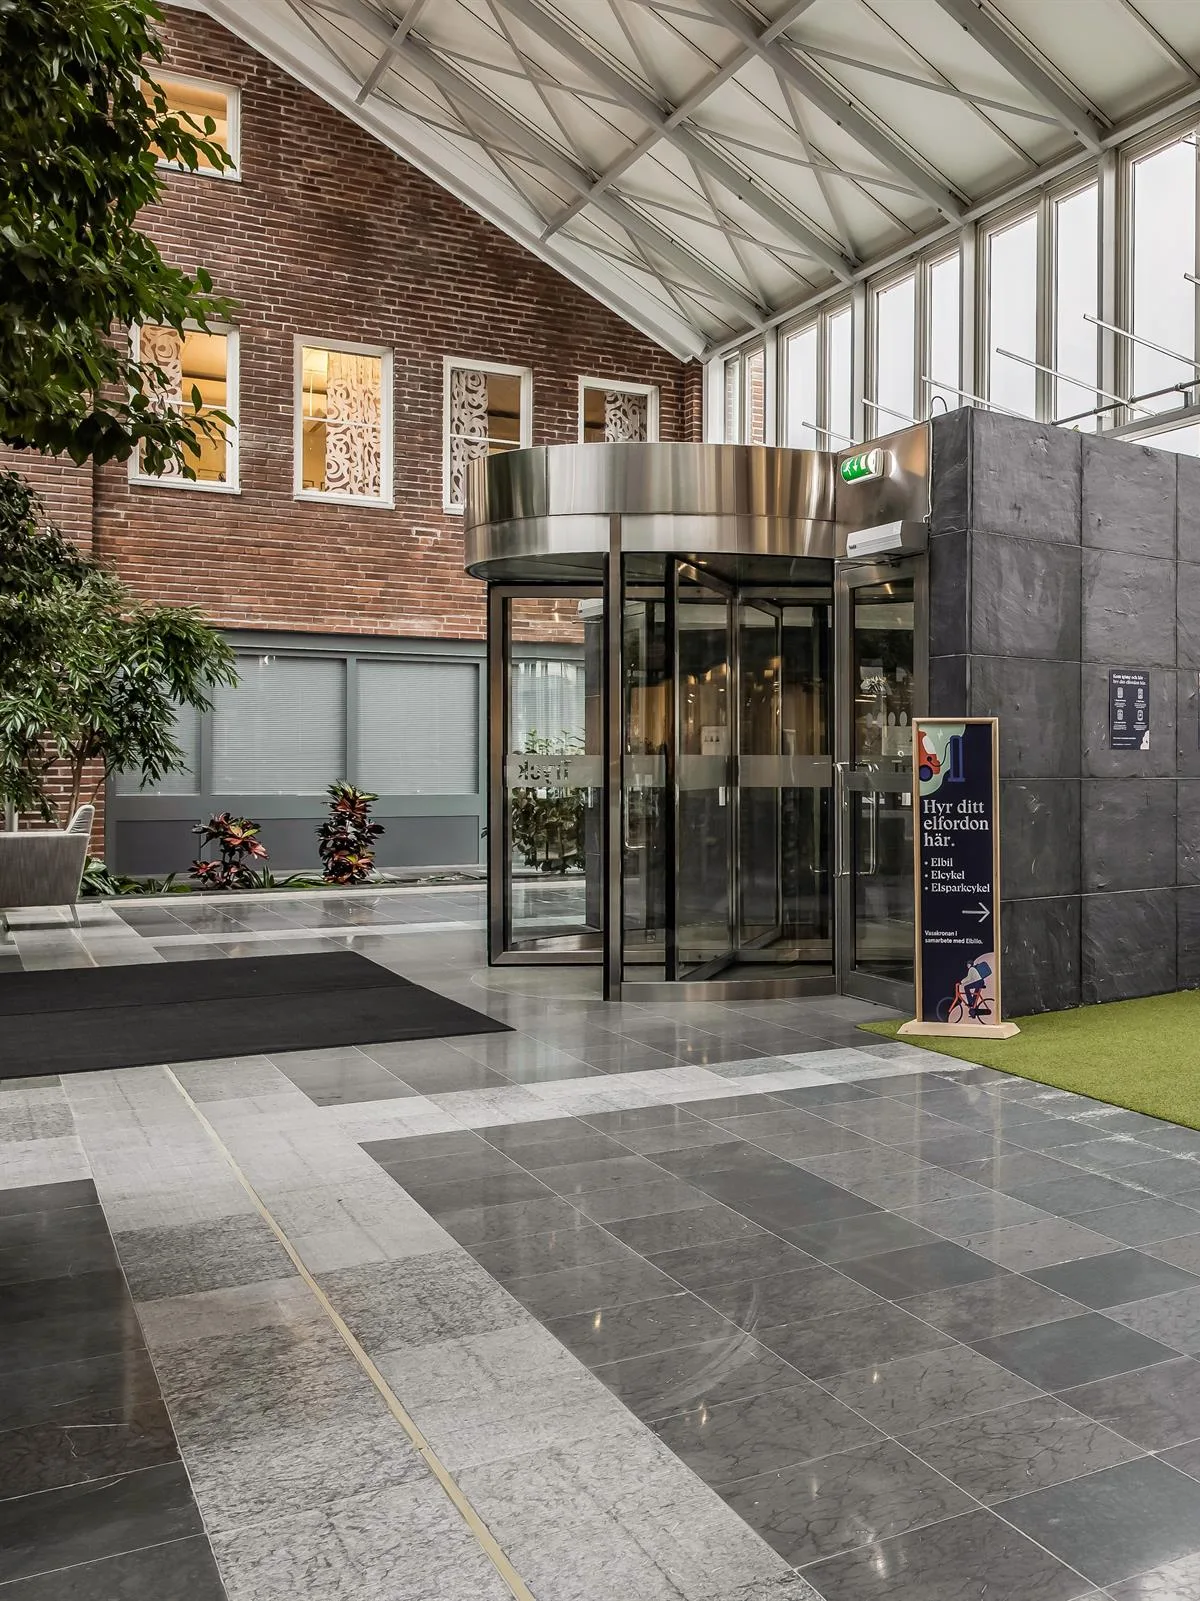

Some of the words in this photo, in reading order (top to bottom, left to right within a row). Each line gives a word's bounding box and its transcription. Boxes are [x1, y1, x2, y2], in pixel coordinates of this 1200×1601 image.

[923, 799, 953, 816] Hyr
[957, 799, 985, 814] ditt
[923, 815, 989, 831] elfordon
[923, 832, 955, 847] här.
[931, 857, 953, 867] Elbil
[931, 870, 965, 880] Elcykel
[931, 882, 990, 893] Elsparkcykel
